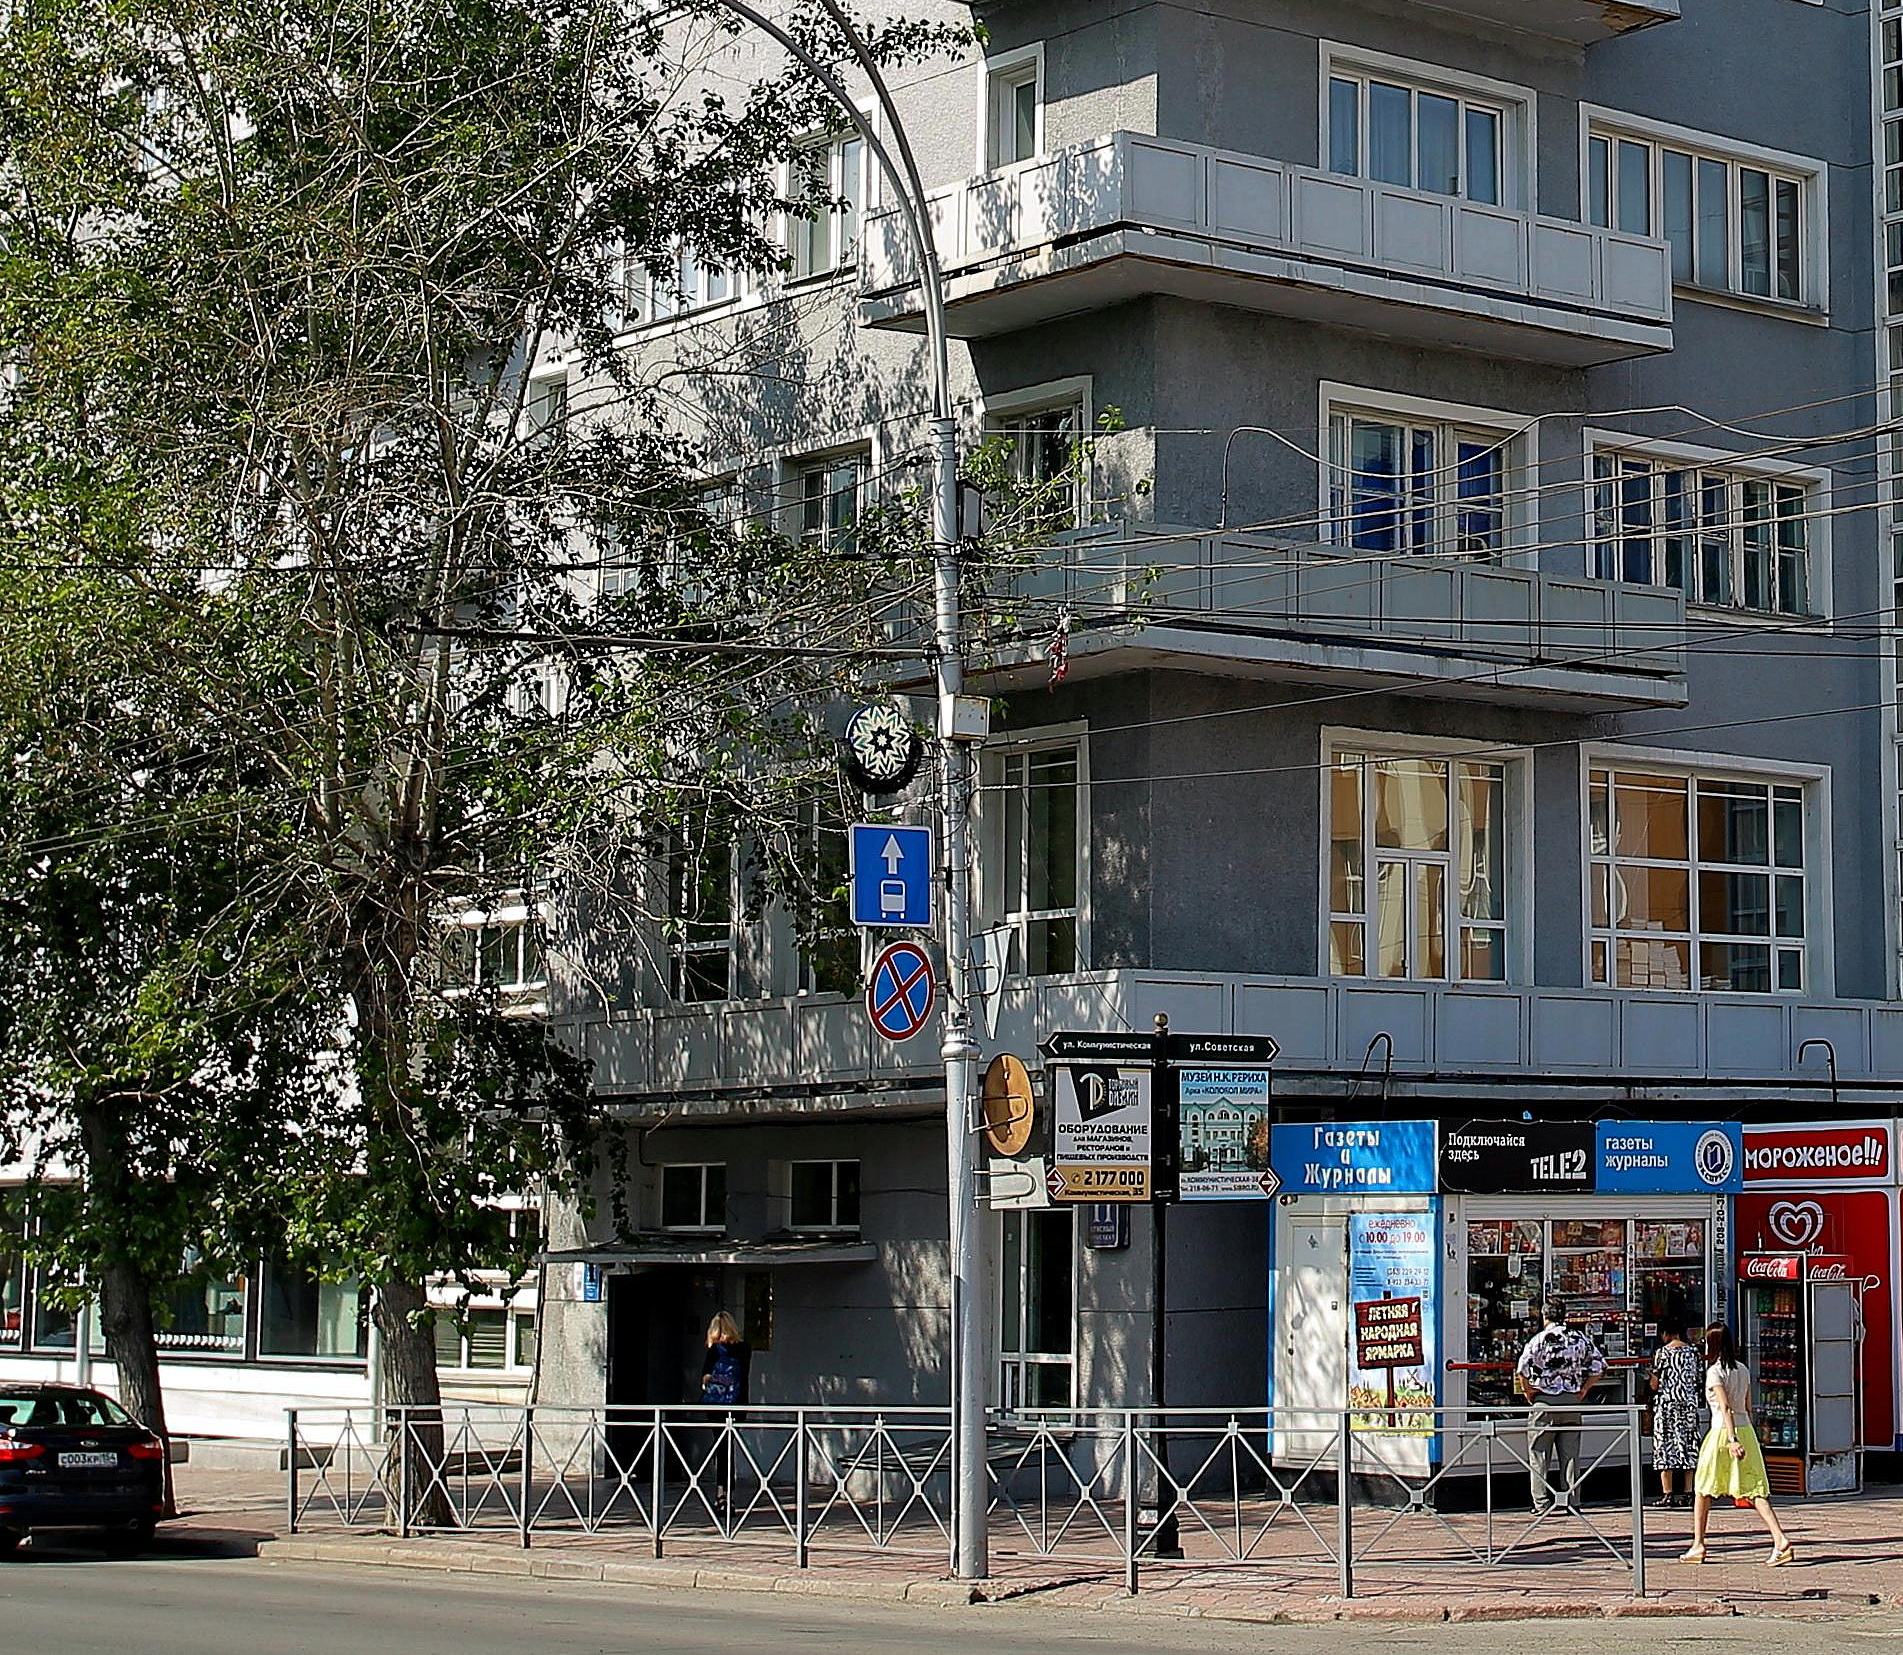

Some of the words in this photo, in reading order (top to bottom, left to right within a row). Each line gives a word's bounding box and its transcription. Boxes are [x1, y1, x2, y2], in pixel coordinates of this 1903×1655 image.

[1181, 1070, 1212, 1082] МУЗЕЙ
[1058, 1124, 1148, 1134] ОБОРУДОВАНИЕ
[1314, 1126, 1380, 1149] Газеты
[1448, 1133, 1525, 1148] Подключайся
[1605, 1137, 1653, 1150] газеты
[1448, 1149, 1480, 1162] здесь
[1530, 1149, 1586, 1179] TELE2
[1605, 1154, 1668, 1171] журналы
[1304, 1163, 1392, 1189] Журналы
[1368, 1303, 1409, 1321] ЛЕТНЯЯ
[1360, 1322, 1418, 1341] НАРОДНАЯ
[1365, 1343, 1415, 1362] ЯРМАРКА
